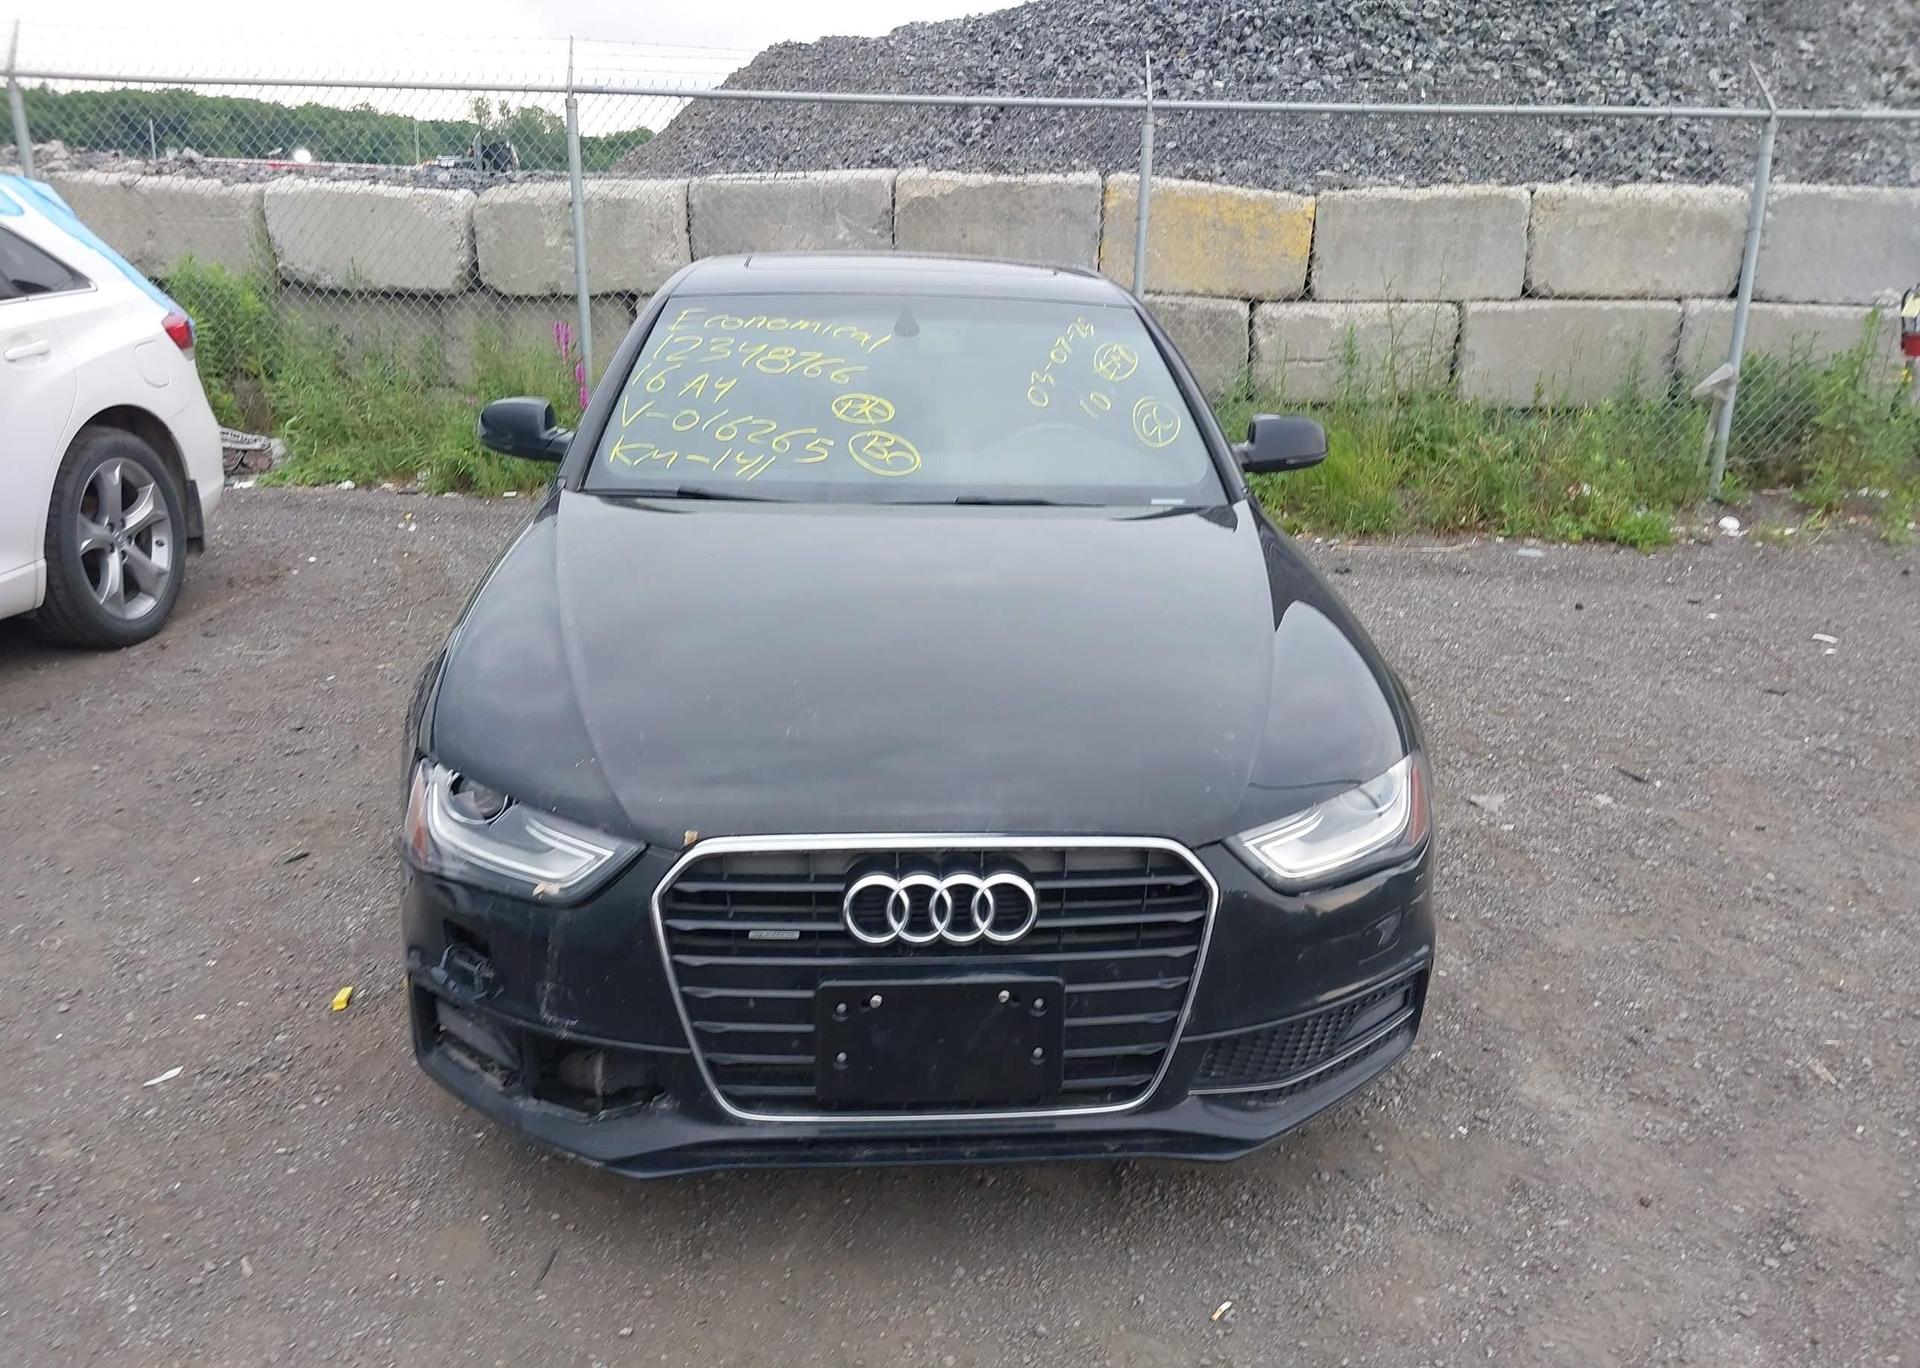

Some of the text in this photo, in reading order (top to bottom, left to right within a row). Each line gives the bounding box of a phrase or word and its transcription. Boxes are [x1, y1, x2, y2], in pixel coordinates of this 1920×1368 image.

[668, 308, 892, 353] Economical
[632, 363, 681, 394] 16
[653, 334, 868, 385] 12348766
